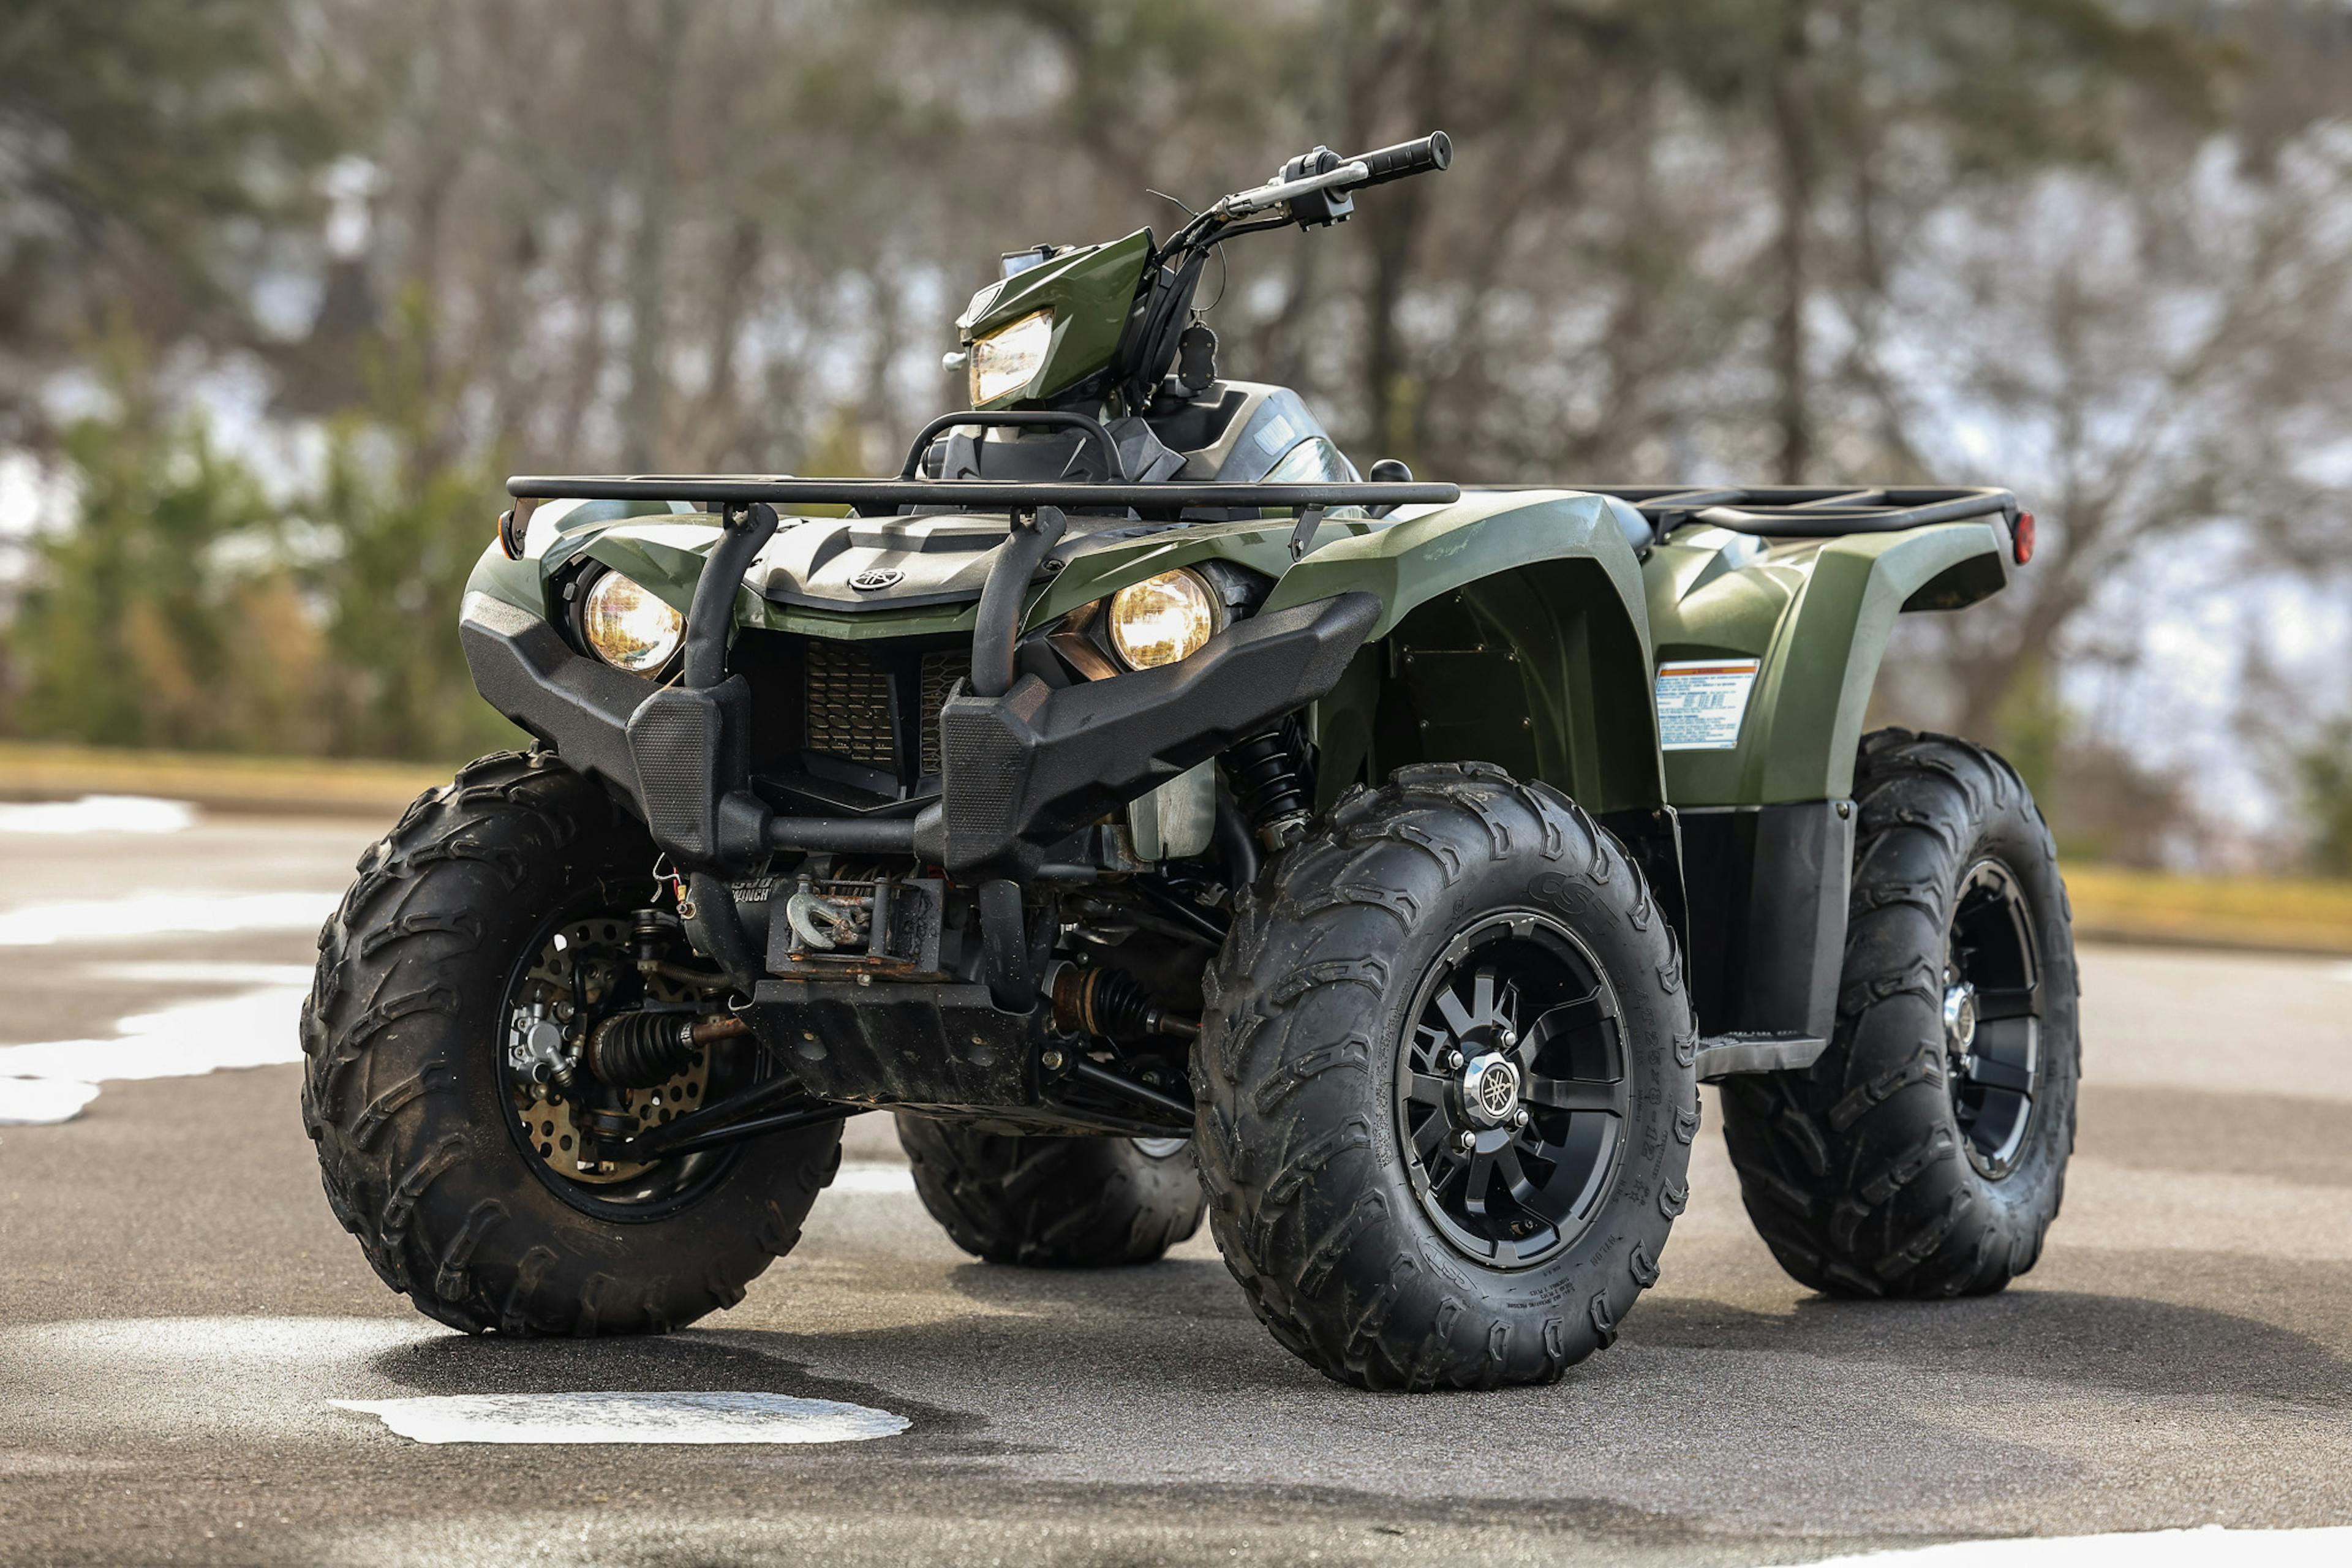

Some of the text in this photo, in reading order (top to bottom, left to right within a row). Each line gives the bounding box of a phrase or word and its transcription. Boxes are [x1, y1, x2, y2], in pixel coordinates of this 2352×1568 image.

[732, 888, 769, 903] WINCH
[1528, 870, 1621, 935] CST
[1590, 1234, 1617, 1266] NYLON
